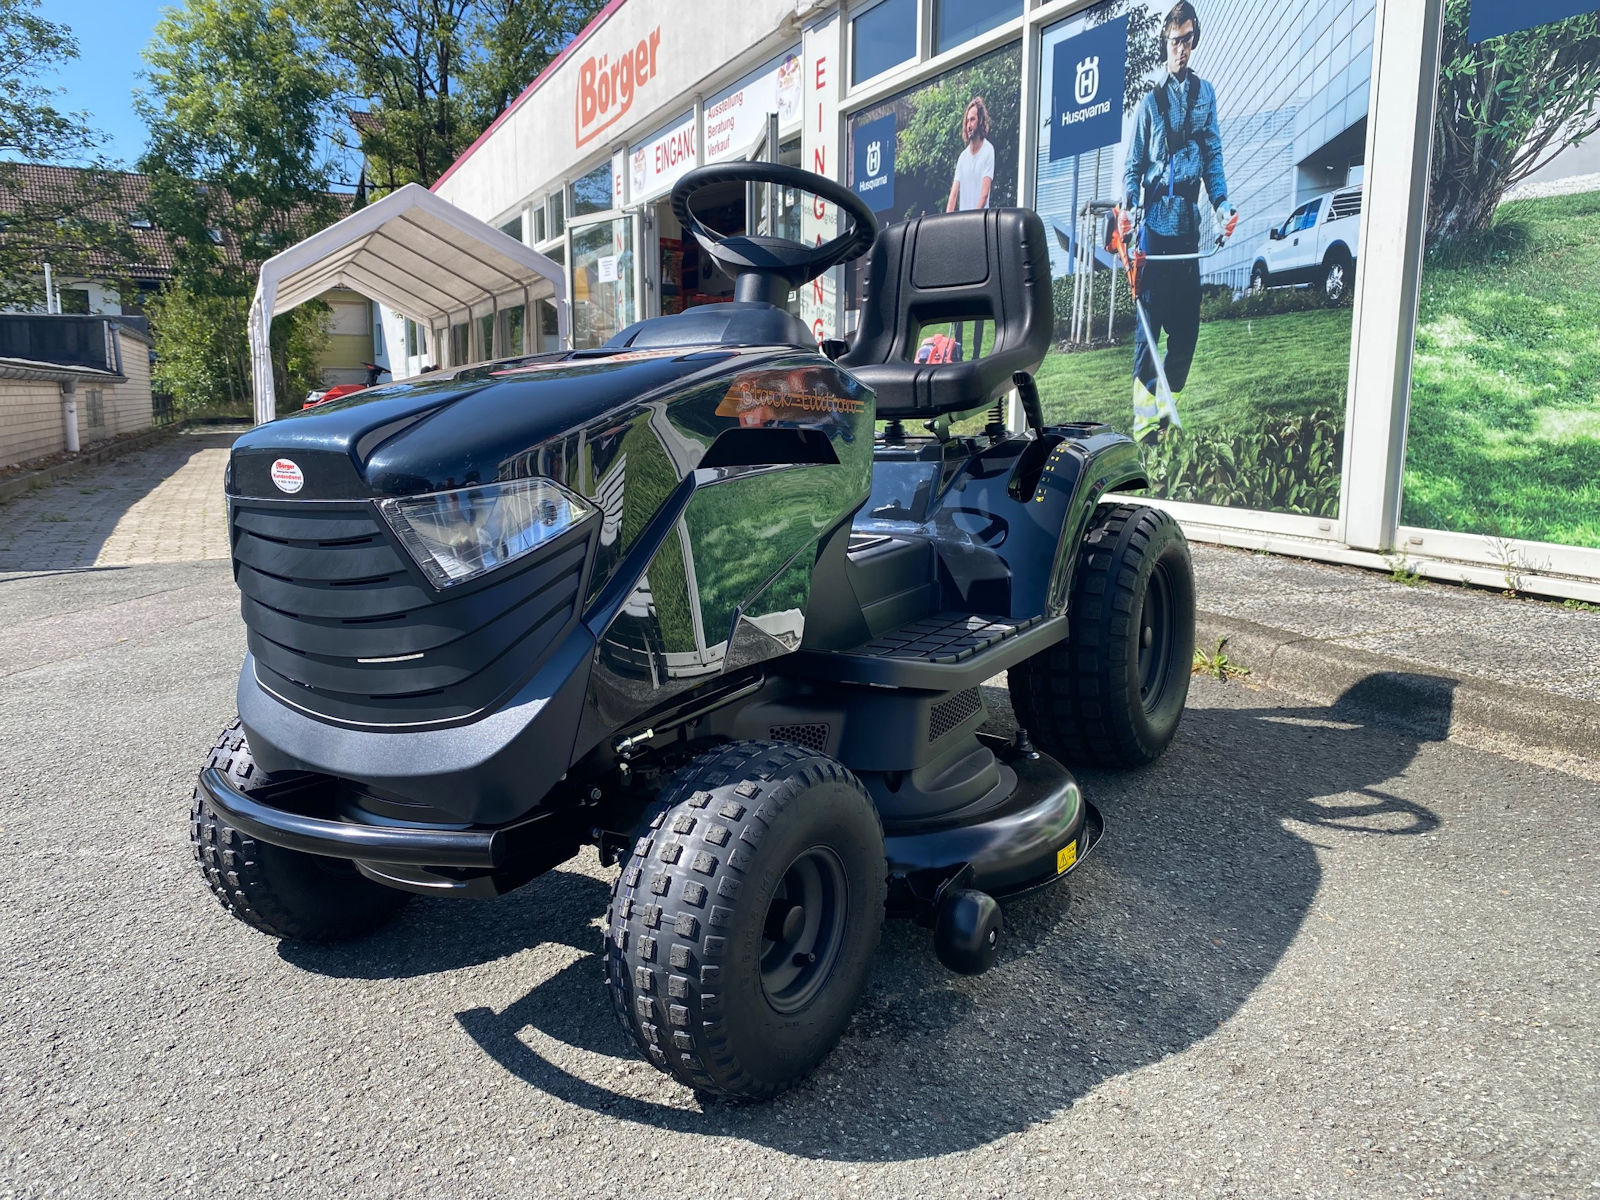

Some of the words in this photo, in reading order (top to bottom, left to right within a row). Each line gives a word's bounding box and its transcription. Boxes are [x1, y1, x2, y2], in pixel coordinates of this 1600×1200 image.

[579, 24, 661, 131] Börger
[707, 91, 744, 121] Ausstellung
[1061, 100, 1111, 127] Husqvarna
[707, 116, 735, 139] Beratung
[707, 134, 730, 157] Verkauf
[859, 175, 888, 193] Husqvarna
[740, 379, 792, 408] Black
[799, 387, 857, 414] Edition
